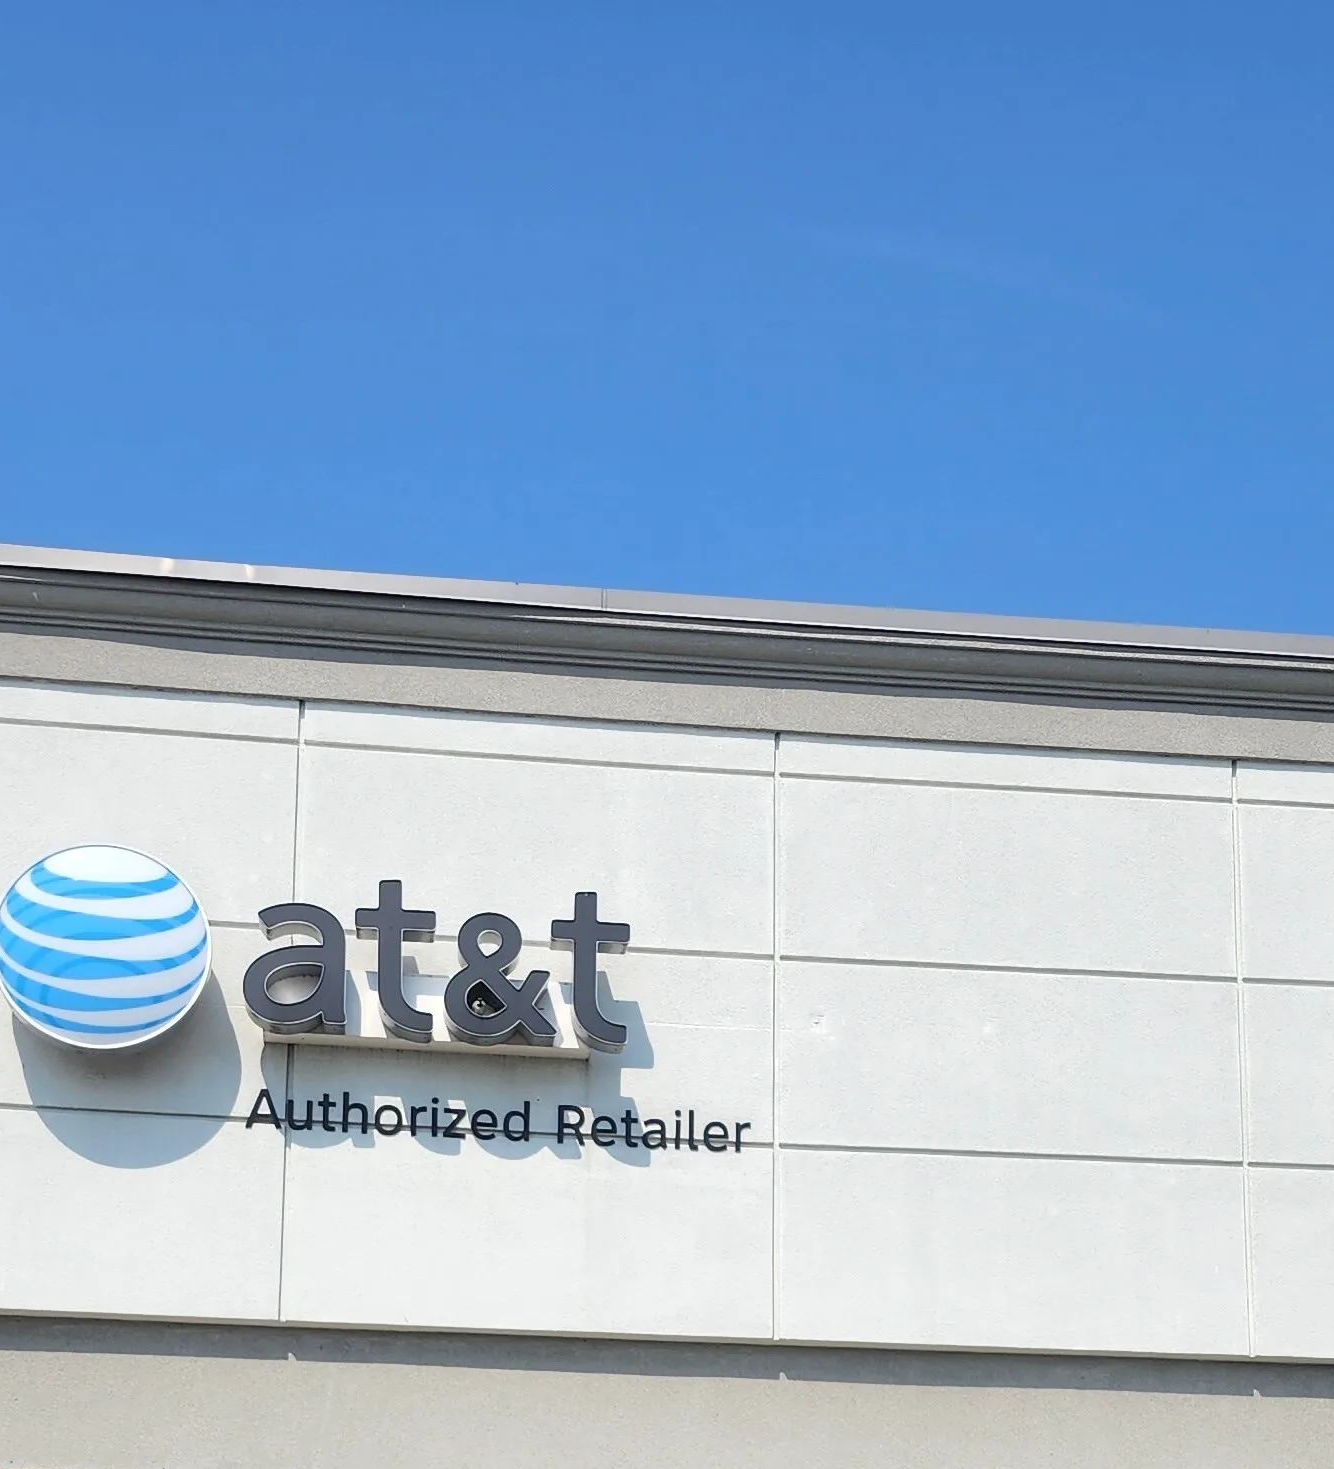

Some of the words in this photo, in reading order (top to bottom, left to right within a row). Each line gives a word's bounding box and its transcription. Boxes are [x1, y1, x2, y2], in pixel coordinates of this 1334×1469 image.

[241, 879, 631, 1053] at&t
[245, 1088, 533, 1143] Authorized
[556, 1104, 753, 1154] Retailer
